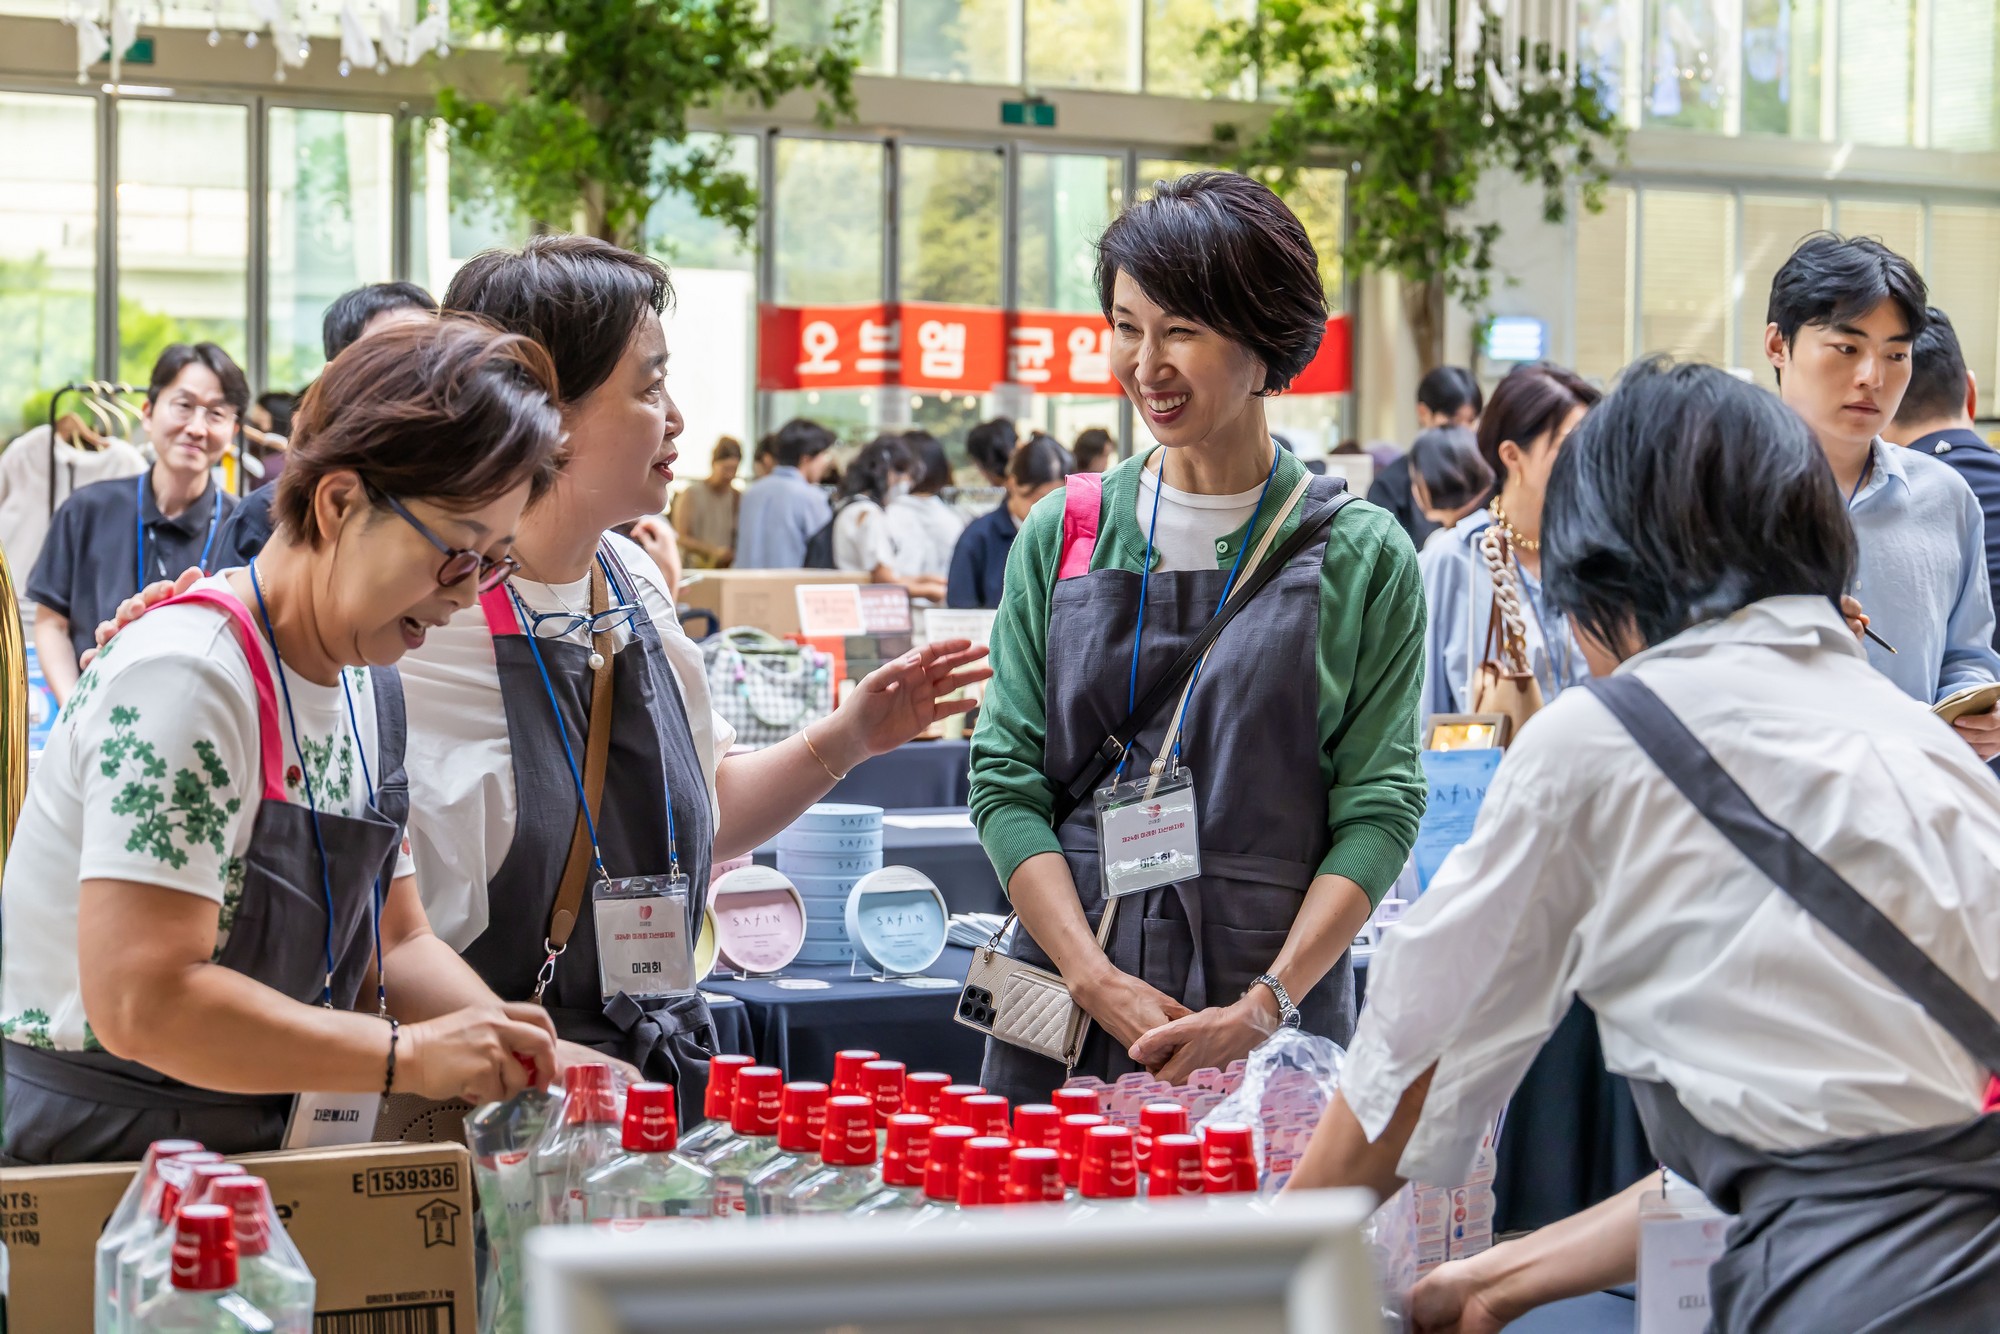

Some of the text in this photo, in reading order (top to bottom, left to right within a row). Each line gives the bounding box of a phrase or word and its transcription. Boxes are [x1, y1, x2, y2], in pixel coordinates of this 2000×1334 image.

[796, 319, 966, 379] 오브엠
[1426, 784, 1486, 805] AfIN
[1140, 830, 1157, 839] 미래회
[632, 961, 661, 974] 미래회
[352, 1167, 455, 1192] E 1539336
